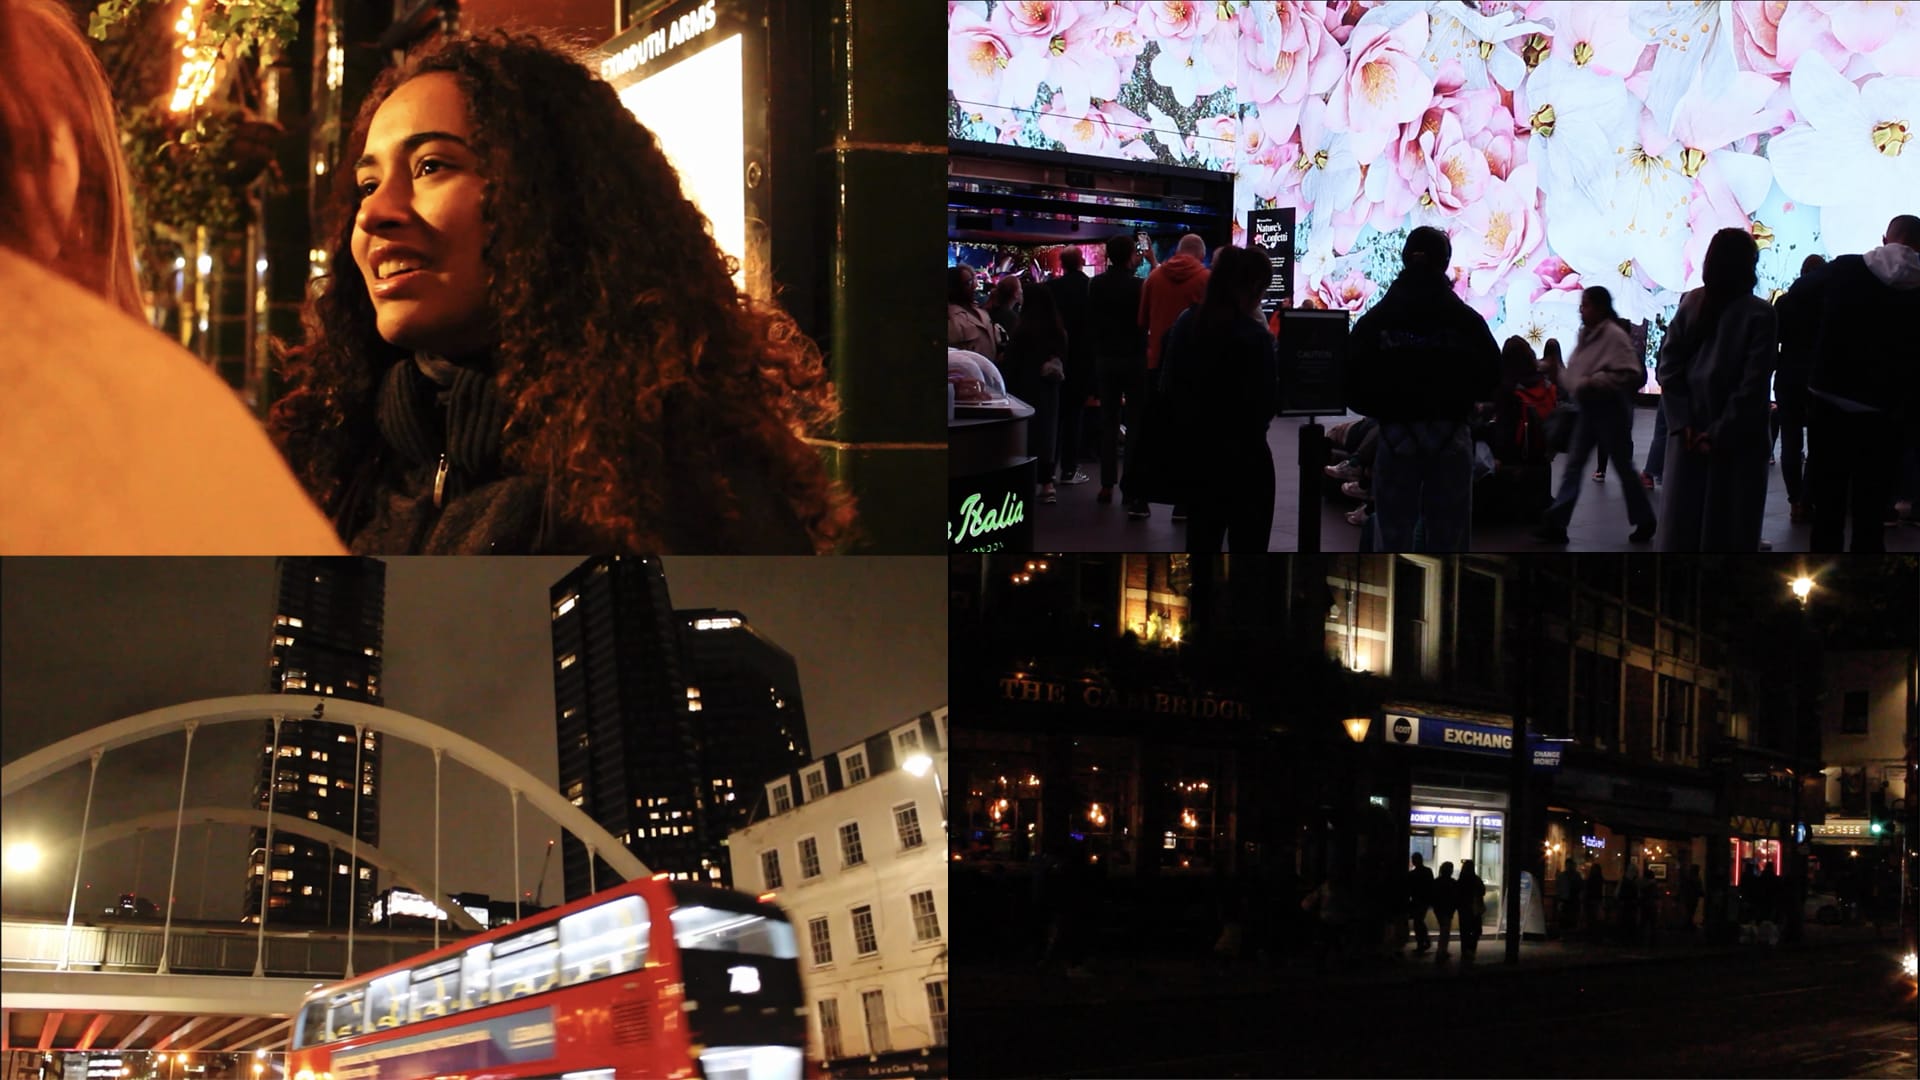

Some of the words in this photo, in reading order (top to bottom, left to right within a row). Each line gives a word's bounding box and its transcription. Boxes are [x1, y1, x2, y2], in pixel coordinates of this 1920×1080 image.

[669, 0, 717, 49] ARMS
[1256, 222, 1282, 233] Nature's
[1262, 232, 1288, 245] Confetti
[954, 491, 1024, 544] Italia
[999, 678, 1068, 704] THE
[1443, 727, 1513, 750] EXCHANG
[1533, 758, 1560, 766] MONEY
[1437, 814, 1470, 824] CHANGE
